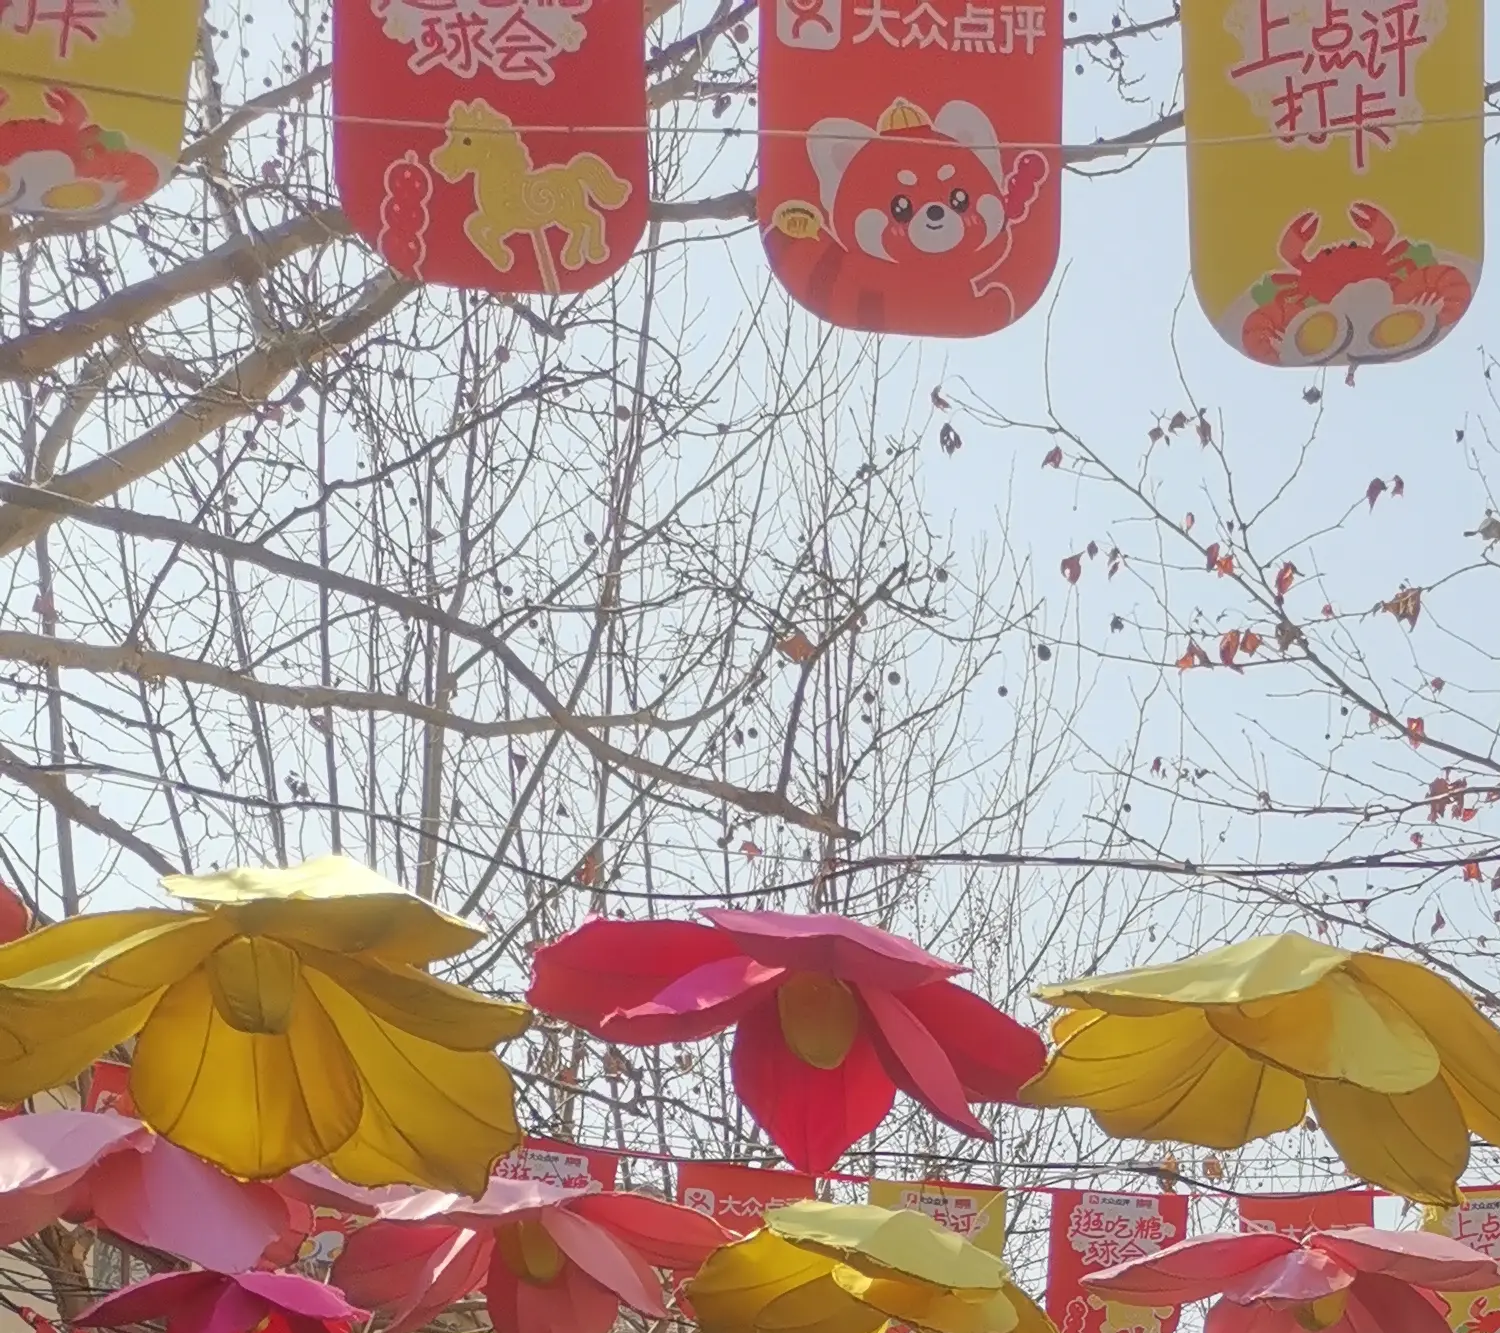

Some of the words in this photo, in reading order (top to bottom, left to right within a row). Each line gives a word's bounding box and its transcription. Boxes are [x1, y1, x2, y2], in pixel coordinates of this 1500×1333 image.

[416, 7, 557, 77] 球会
[852, 0, 1047, 54] 大众点评
[1231, 0, 1427, 97] 上点评
[1271, 76, 1397, 168] 打卡
[1070, 1209, 1162, 1240] 逛吃糖
